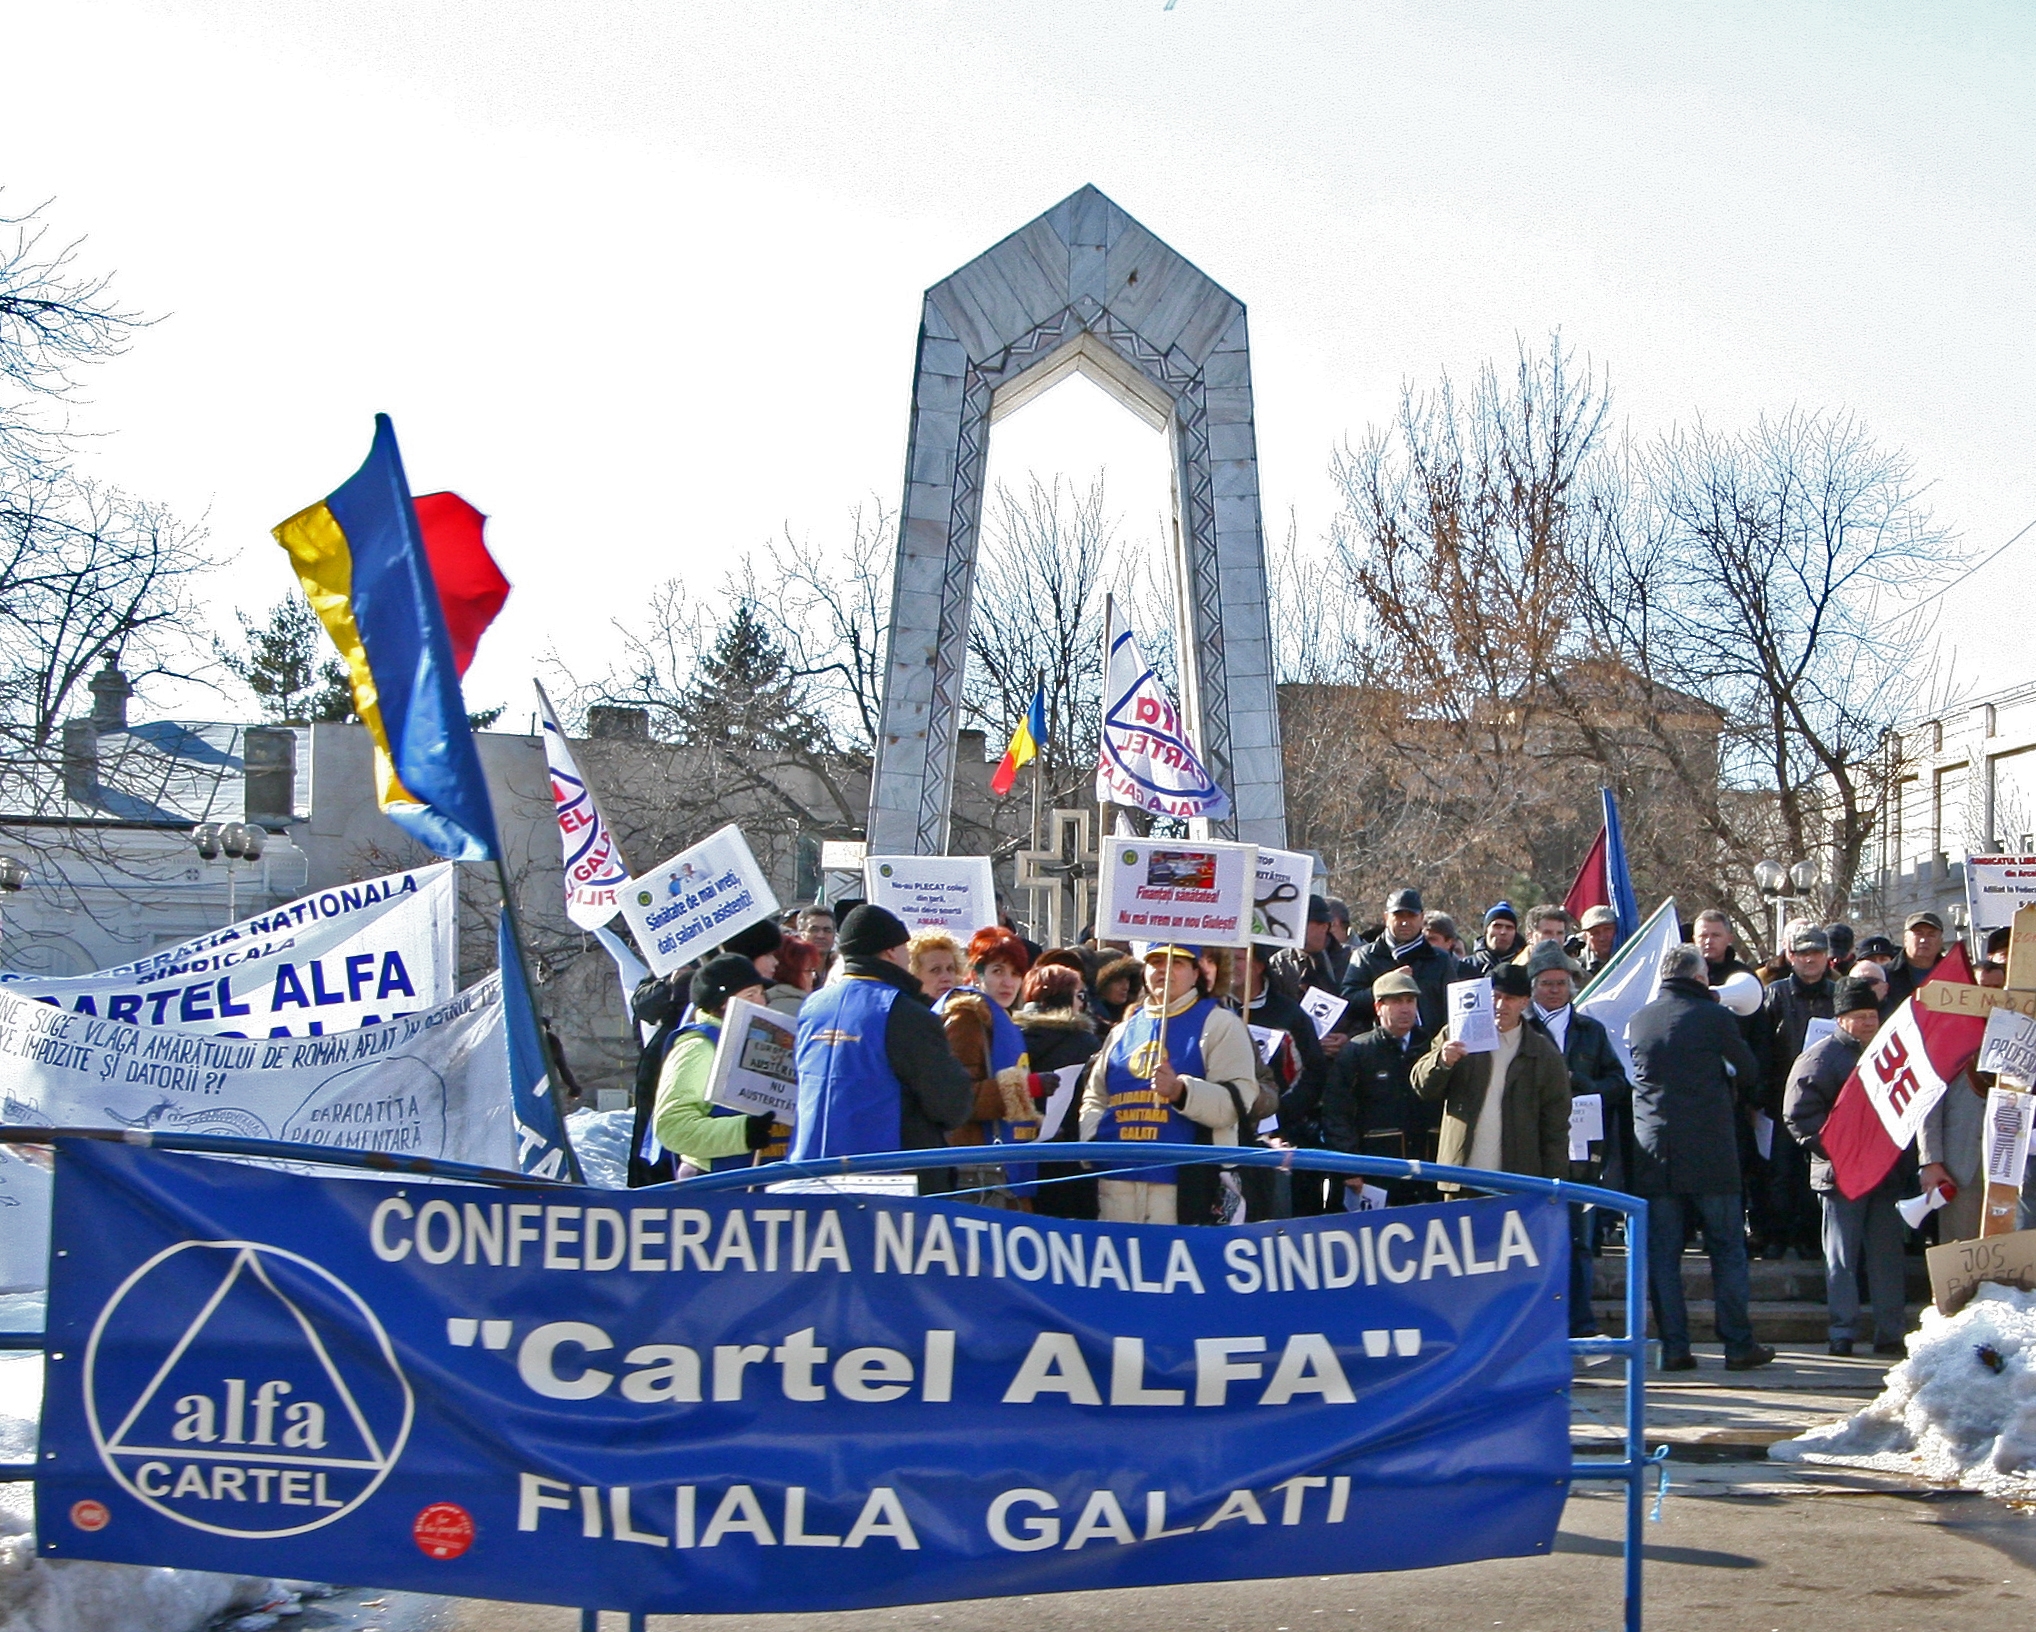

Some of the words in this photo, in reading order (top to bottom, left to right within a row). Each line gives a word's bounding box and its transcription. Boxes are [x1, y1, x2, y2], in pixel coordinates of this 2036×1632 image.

[250, 874, 419, 936] NATIONALA
[270, 950, 416, 1013] ALFA
[29, 1007, 79, 1040] SUGE
[261, 1045, 289, 1070] DE
[351, 1026, 399, 1061] AFLAT
[125, 1060, 201, 1092] DATORII
[770, 1080, 786, 1094] NU
[370, 1197, 852, 1274] CONFEDERATIA
[873, 1210, 1205, 1295] NATIONALA
[1224, 1209, 1540, 1295] SINDICALA
[1959, 1243, 2006, 1273] JOS
[446, 1317, 956, 1404] "Cartel
[1001, 1328, 1421, 1407] ALFA"
[171, 1378, 328, 1450] alfa
[135, 1461, 344, 1509] CARTEL
[517, 1472, 921, 1551] FILIALA
[985, 1475, 1352, 1552] GALATI
